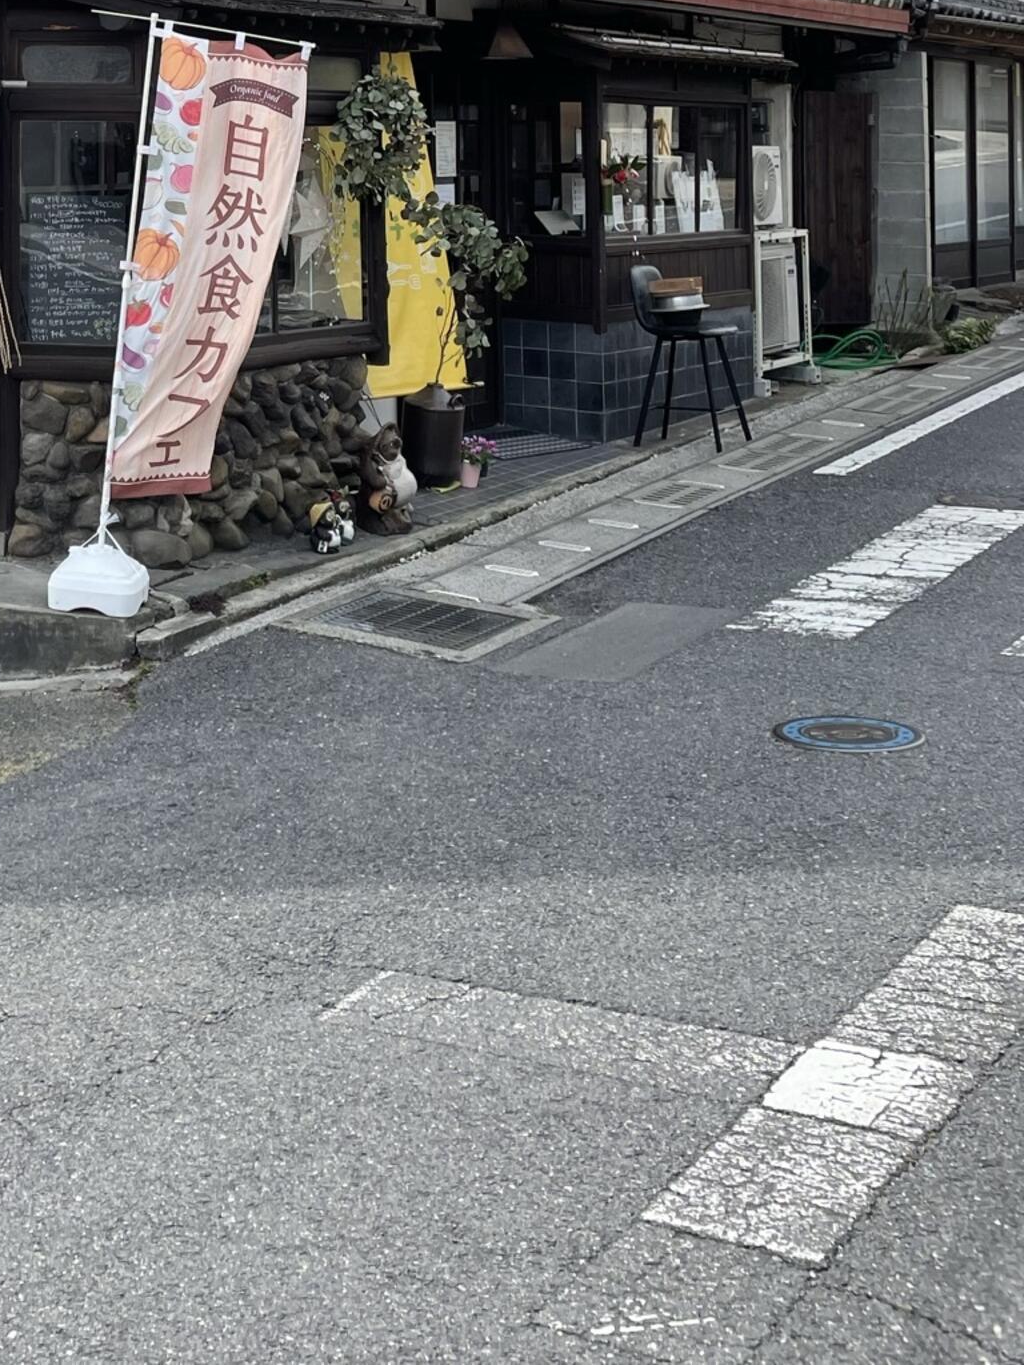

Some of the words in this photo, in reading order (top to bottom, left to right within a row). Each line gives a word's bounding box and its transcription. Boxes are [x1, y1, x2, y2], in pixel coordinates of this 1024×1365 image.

[230, 84, 262, 96] Organic
[262, 90, 282, 103] food
[149, 114, 270, 467] 自然食カフェ
